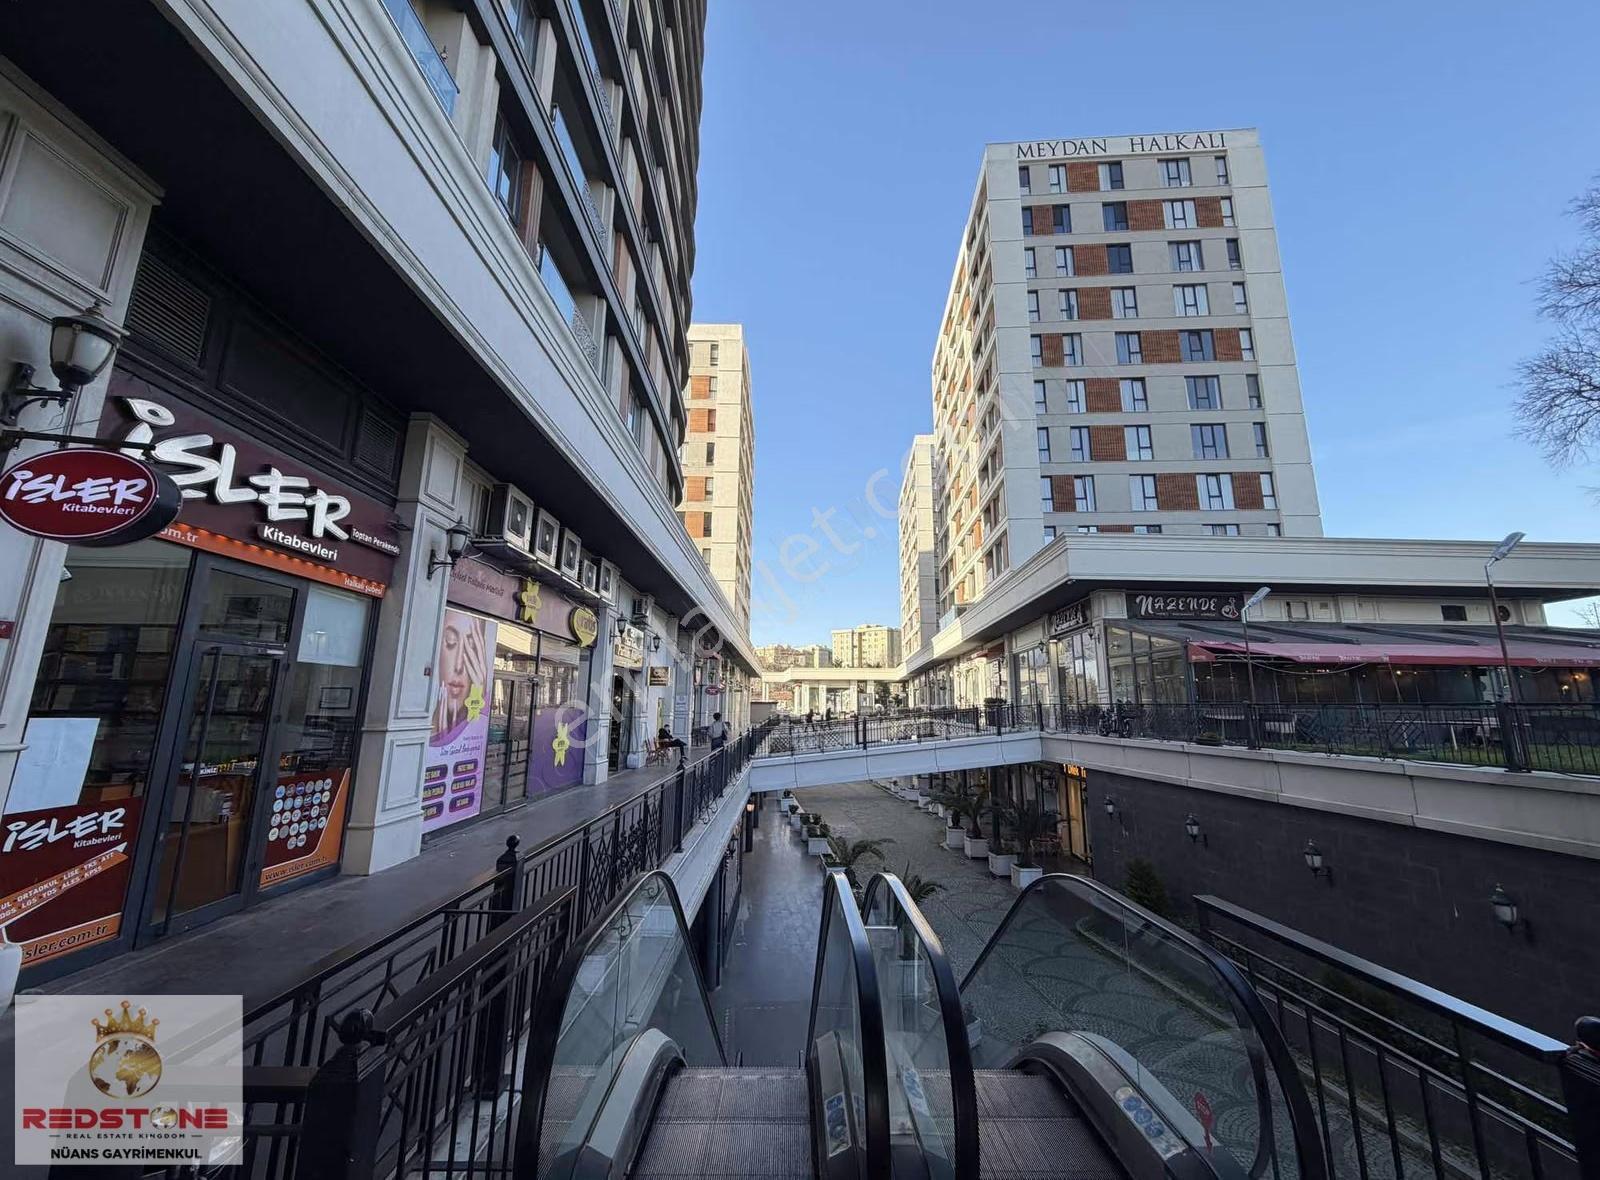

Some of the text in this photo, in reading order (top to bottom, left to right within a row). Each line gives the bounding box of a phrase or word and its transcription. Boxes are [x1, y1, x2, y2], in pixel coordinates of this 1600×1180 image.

[1016, 132, 1226, 159] MEYDAN HALKALI
[5, 470, 148, 505] İŞLER
[62, 503, 135, 515] Kitabevleri
[263, 525, 338, 561] Kitabevleri
[352, 528, 373, 543] Toptan
[1136, 595, 1216, 615] NAZENDE
[2, 807, 126, 852] İŞLER
[73, 832, 122, 848] Kitabevleri
